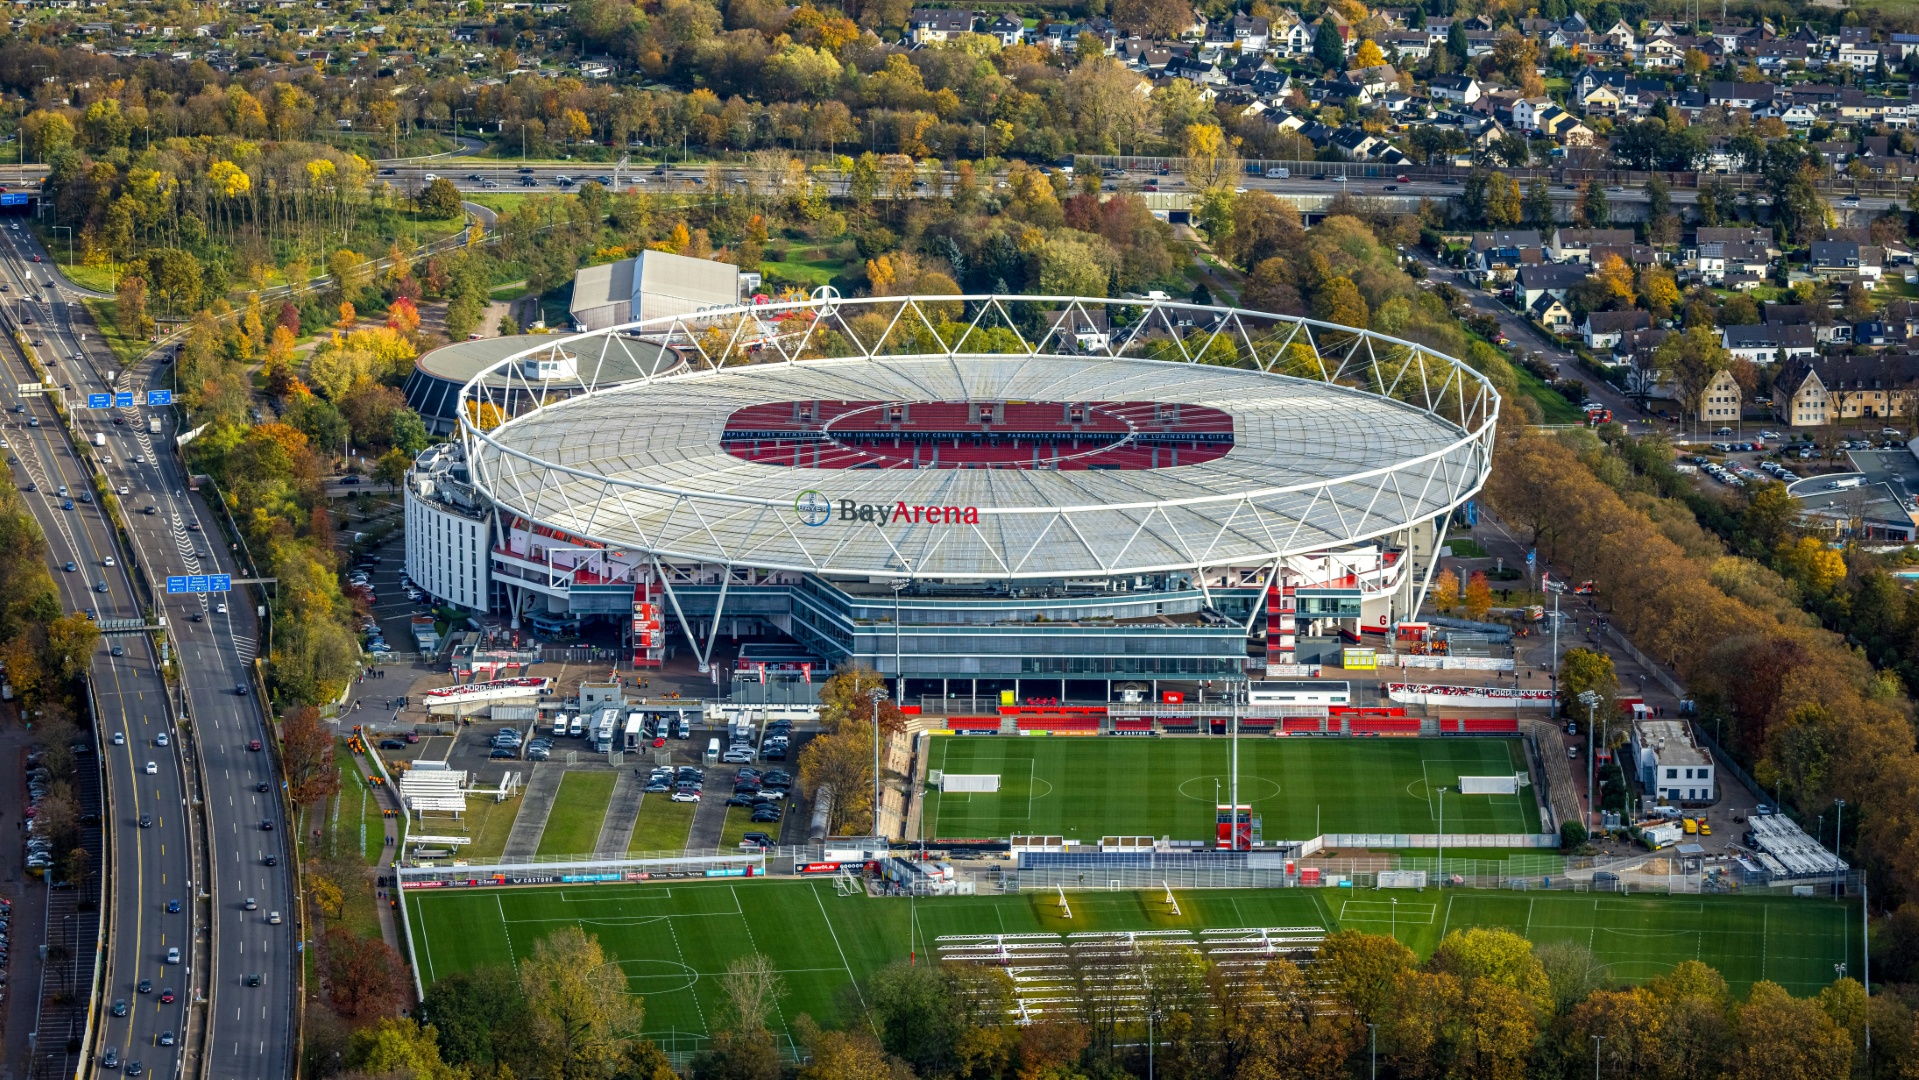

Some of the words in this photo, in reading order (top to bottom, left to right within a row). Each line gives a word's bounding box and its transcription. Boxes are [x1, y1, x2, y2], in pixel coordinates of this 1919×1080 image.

[798, 504, 827, 512] BAYER
[838, 499, 979, 527] BayArena
[1379, 615, 1387, 625] G
